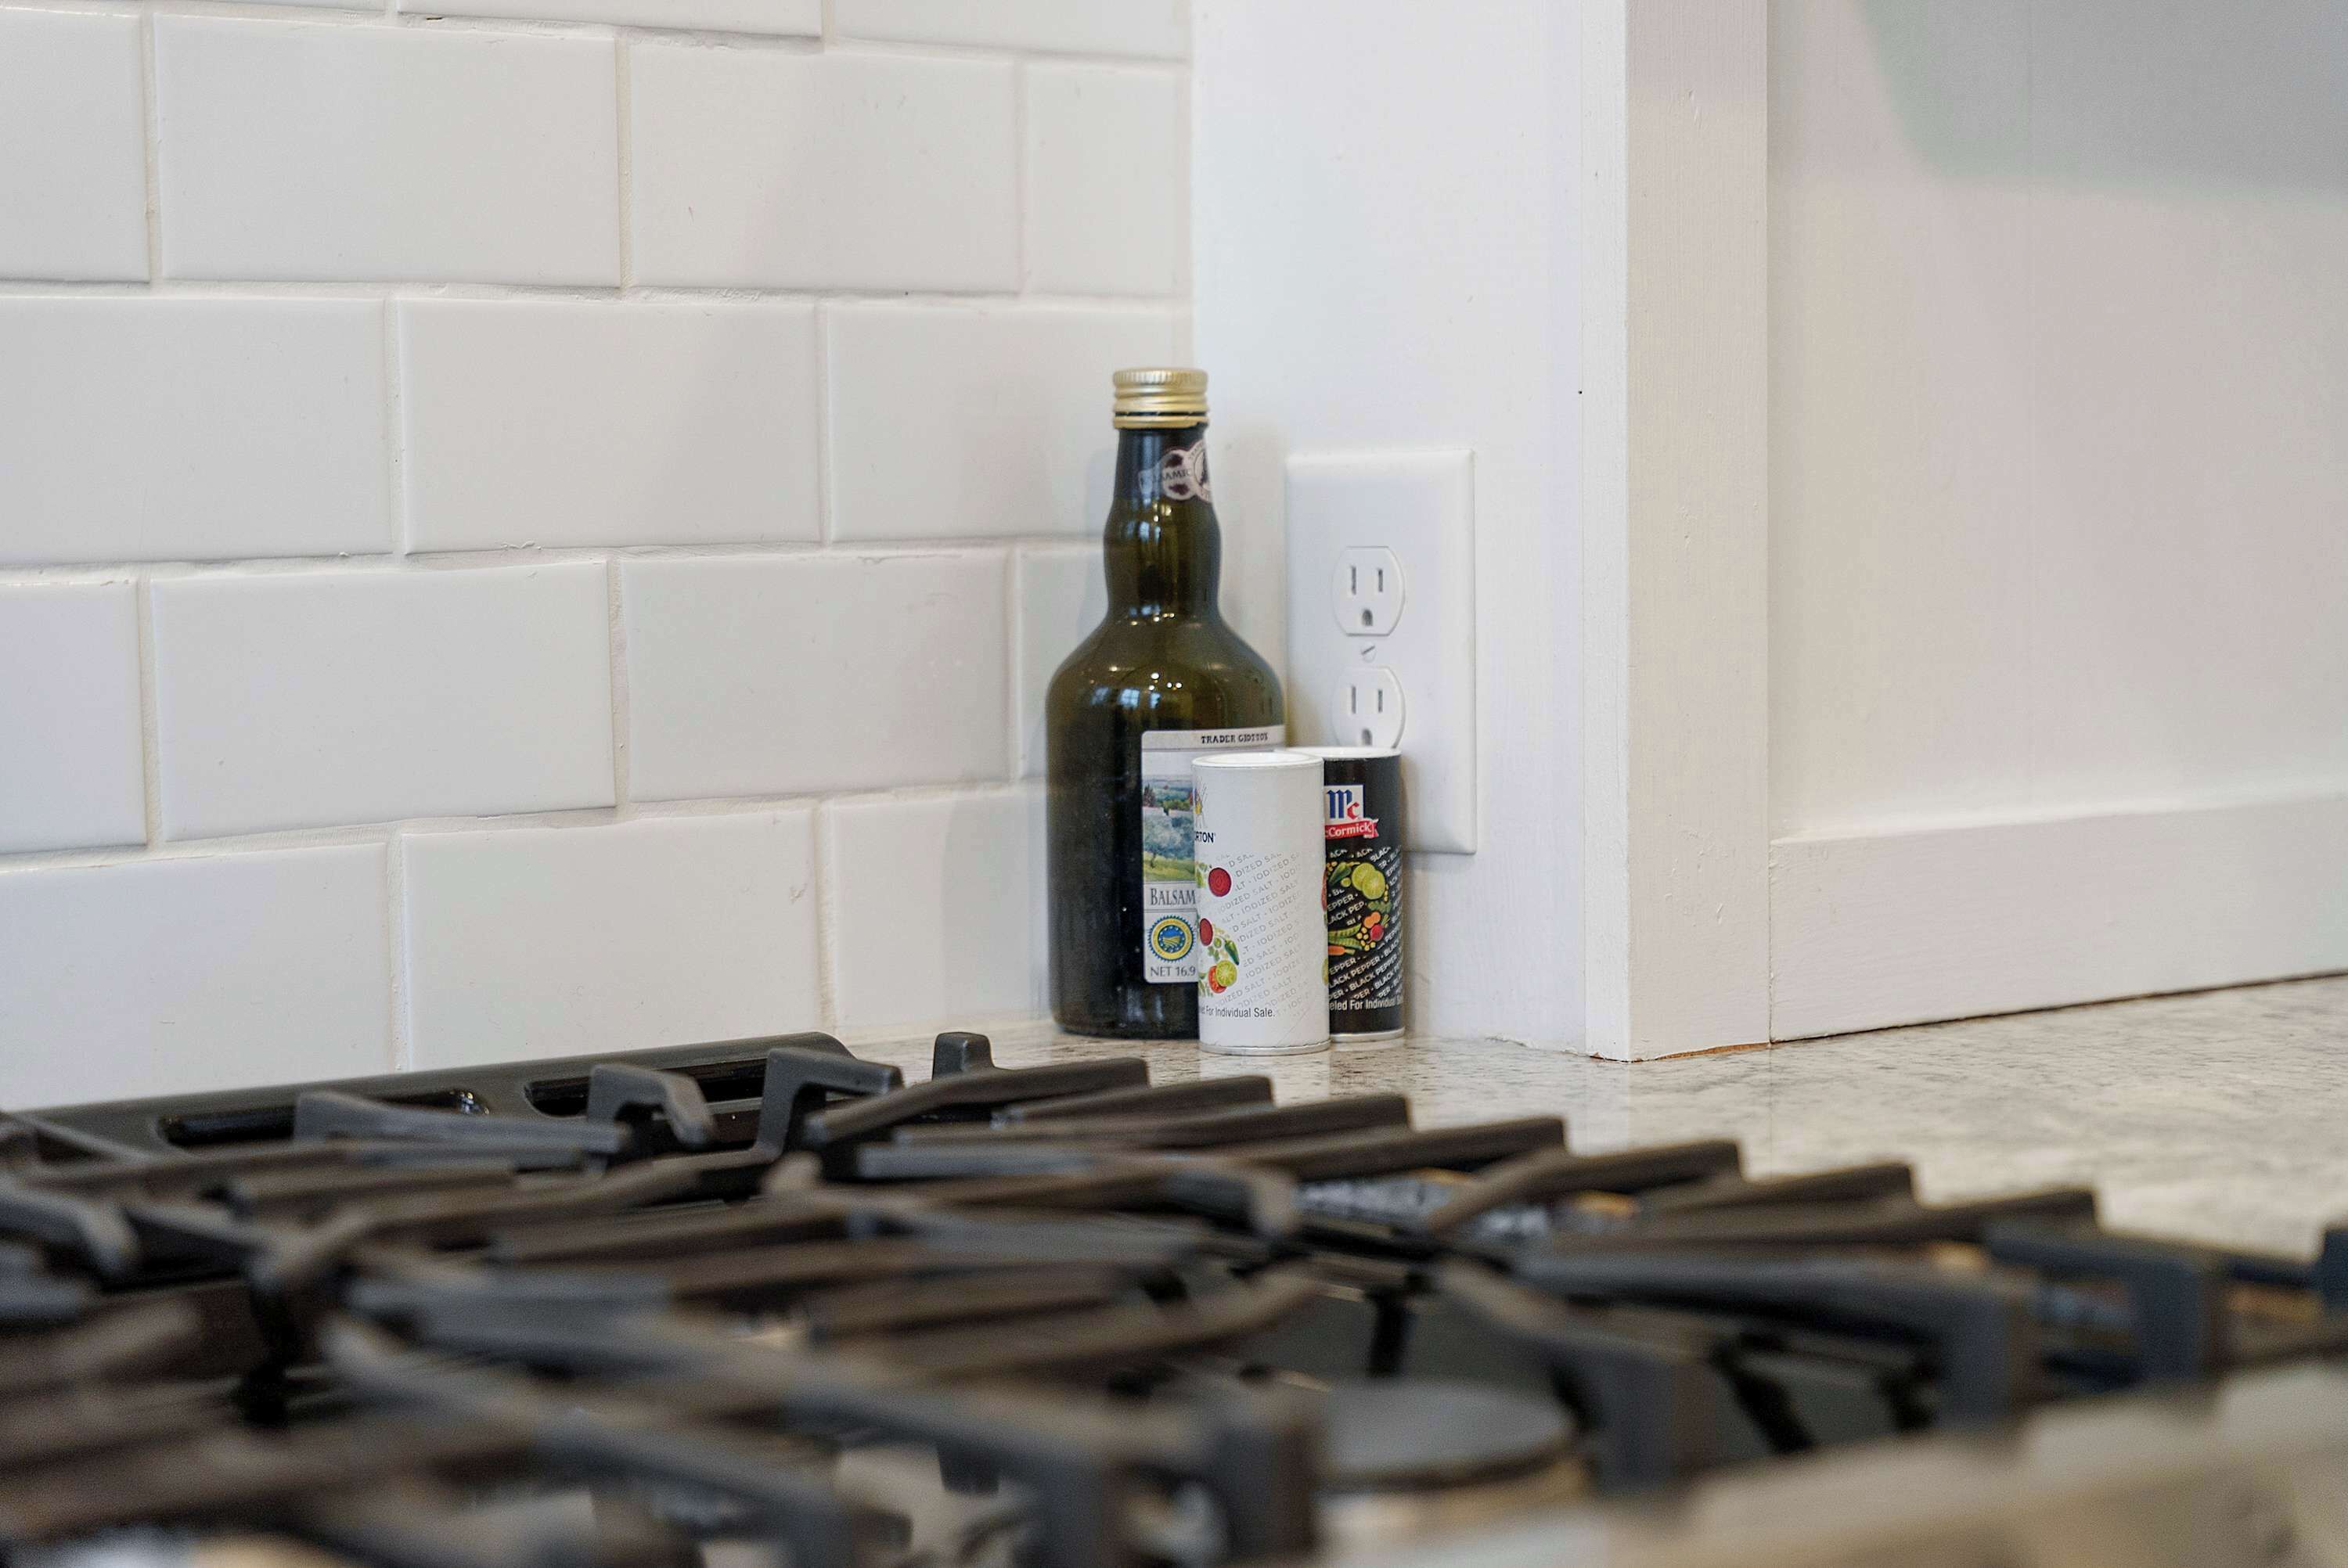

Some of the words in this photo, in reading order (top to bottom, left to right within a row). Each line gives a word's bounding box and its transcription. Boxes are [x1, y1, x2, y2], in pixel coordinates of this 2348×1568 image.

[1201, 734, 1236, 744] TRADER
[1194, 831, 1214, 843] RTON
[1151, 888, 1196, 905] BALSAM
[1241, 892, 1278, 914] IODIZED
[1151, 966, 1172, 977] NET
[1176, 966, 1196, 977] 16.9
[1350, 955, 1381, 976] PEPPER
[1349, 972, 1376, 991] BLACK
[1349, 999, 1363, 1010] For
[1215, 1006, 1251, 1018] Individual
[1254, 1007, 1276, 1018] Sale.
